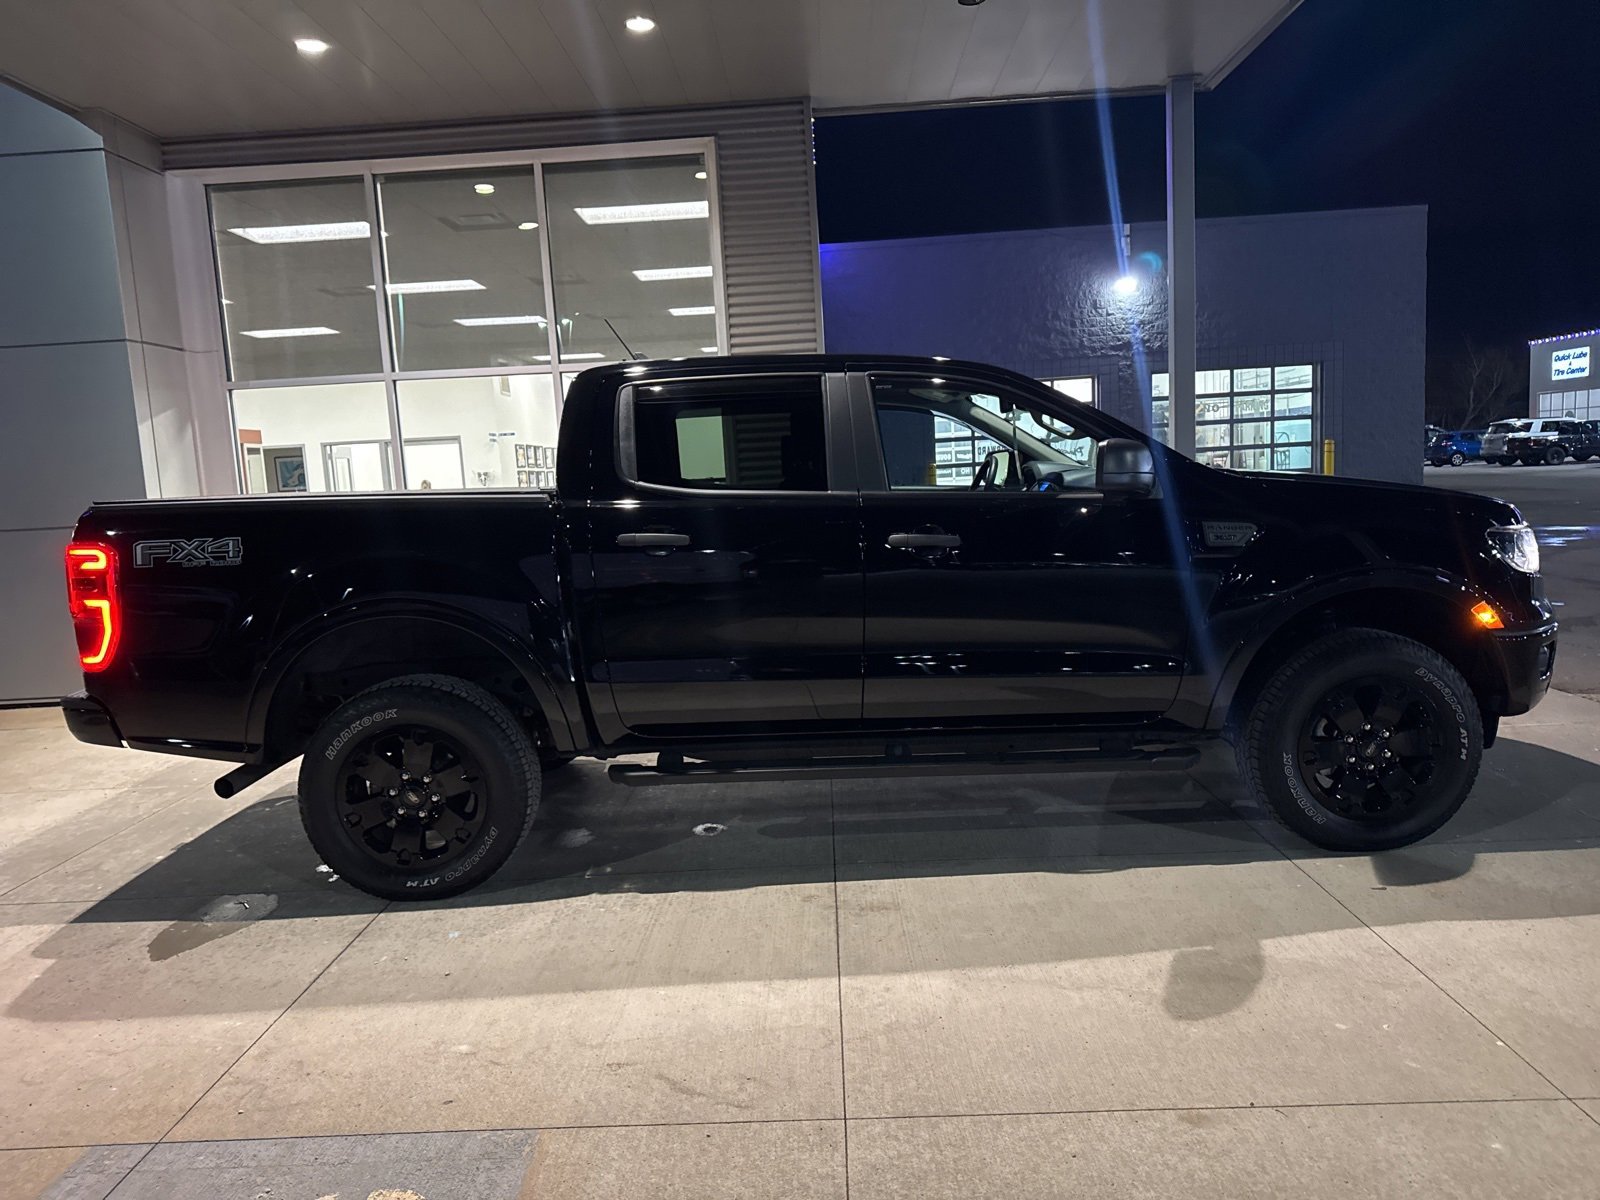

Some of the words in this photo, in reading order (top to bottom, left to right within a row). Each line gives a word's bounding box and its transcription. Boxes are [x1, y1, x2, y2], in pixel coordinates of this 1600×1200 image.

[1554, 353, 1571, 362] Quick
[1572, 351, 1587, 359] Lube
[1553, 369, 1565, 377] Tire
[1566, 366, 1587, 375] Center
[132, 536, 244, 568] FX4
